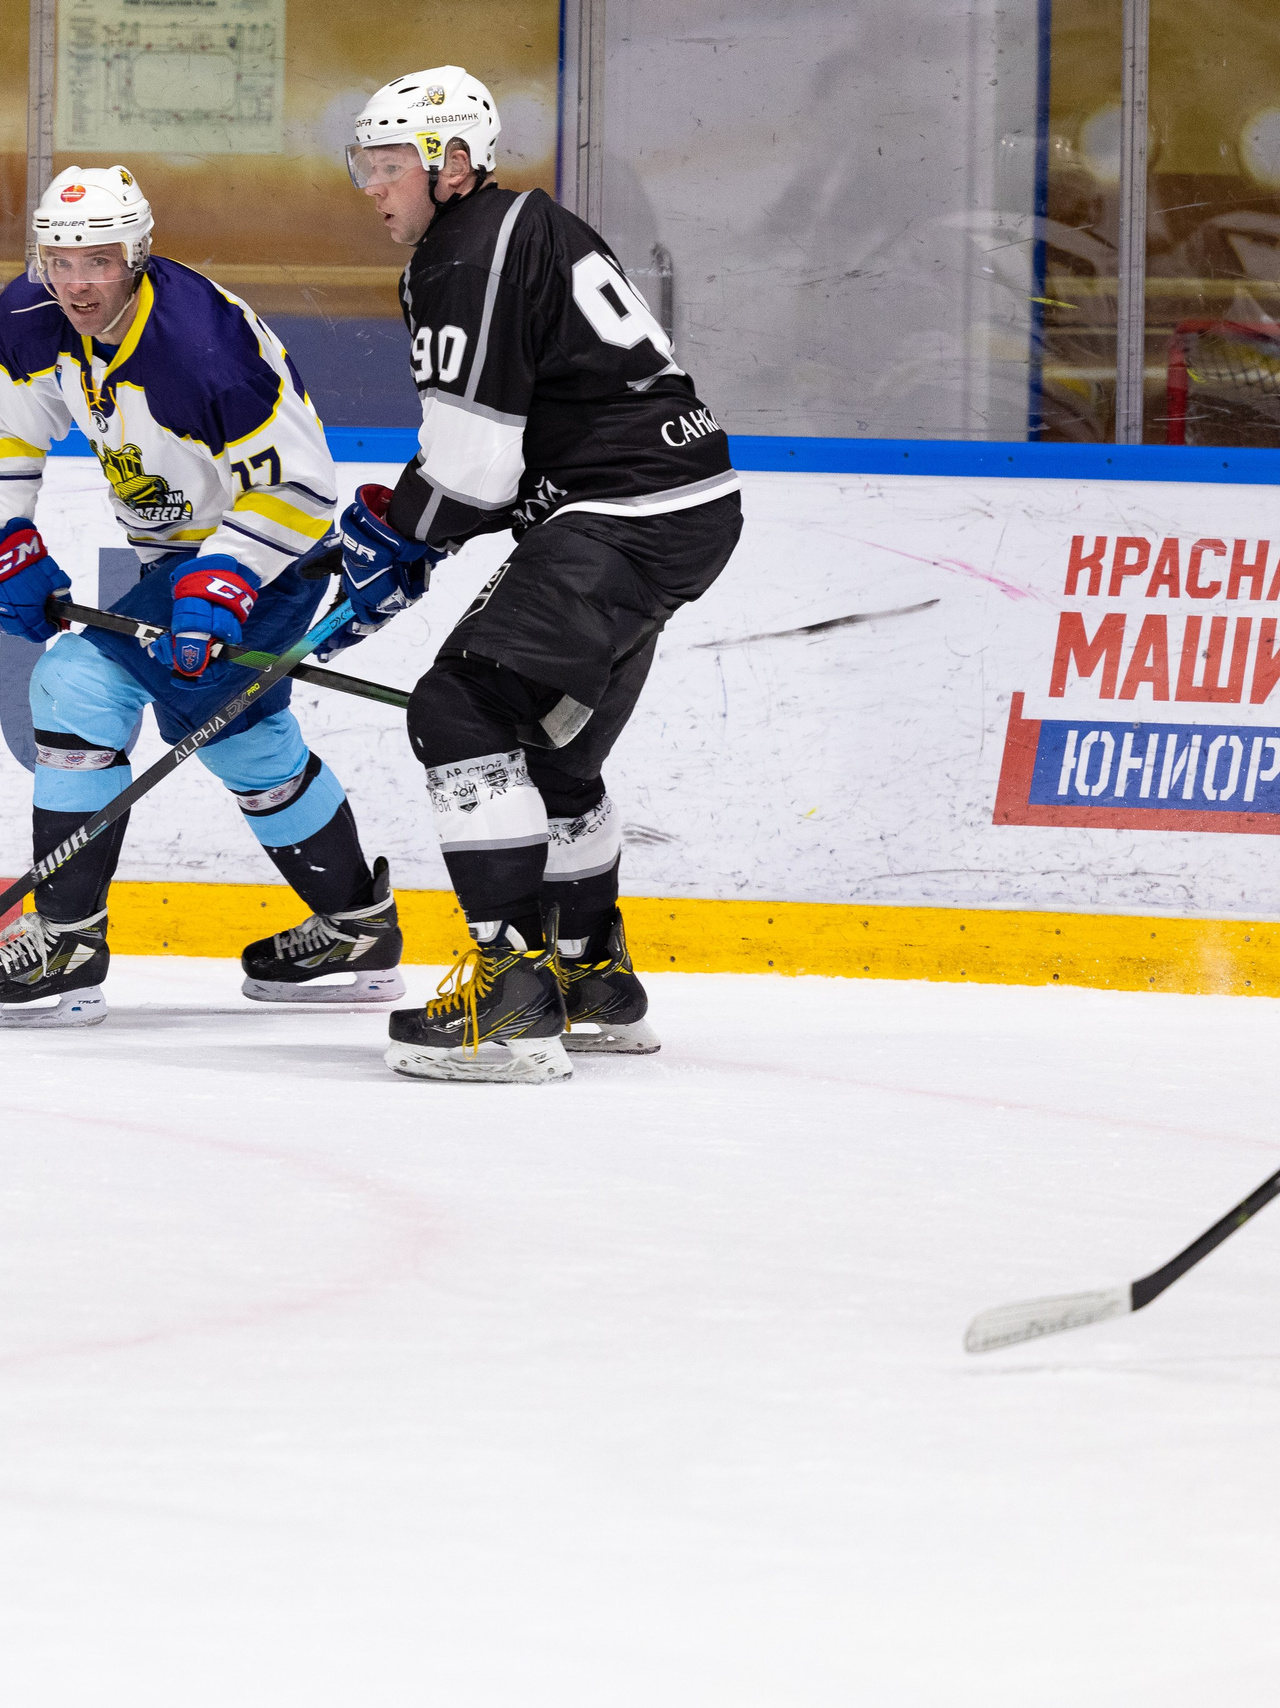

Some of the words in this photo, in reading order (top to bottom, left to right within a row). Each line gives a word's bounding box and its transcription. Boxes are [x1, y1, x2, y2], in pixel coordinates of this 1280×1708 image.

[426, 112, 479, 124] Невалинк
[572, 250, 686, 391] 9
[412, 325, 468, 383] 90
[661, 407, 721, 447] САНК
[340, 532, 377, 563] ER
[1064, 535, 1280, 601] КРАСН
[204, 574, 255, 616] CC
[174, 716, 227, 763] ALPHA
[246, 682, 261, 696] PRO
